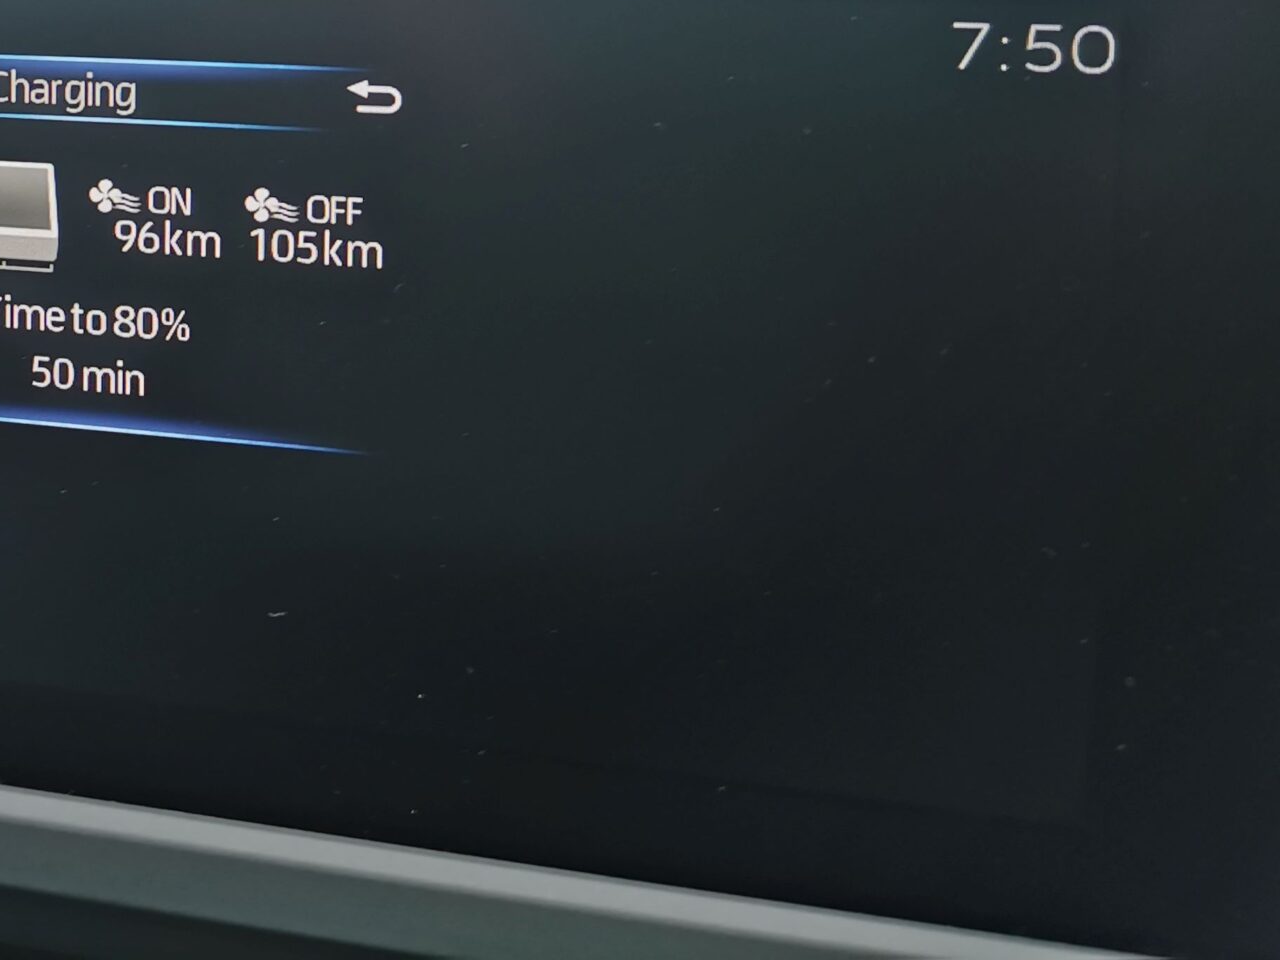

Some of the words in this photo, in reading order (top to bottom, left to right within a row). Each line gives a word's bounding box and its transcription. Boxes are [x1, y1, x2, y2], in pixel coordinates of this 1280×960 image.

[952, 21, 1116, 75] 7:50
[147, 185, 193, 217] ON
[306, 194, 365, 226] OFF
[114, 219, 222, 260] 96km
[250, 228, 384, 270] 105km
[70, 302, 108, 337] to
[112, 305, 191, 343] 80%
[30, 355, 76, 391] 50
[81, 359, 146, 397] min
